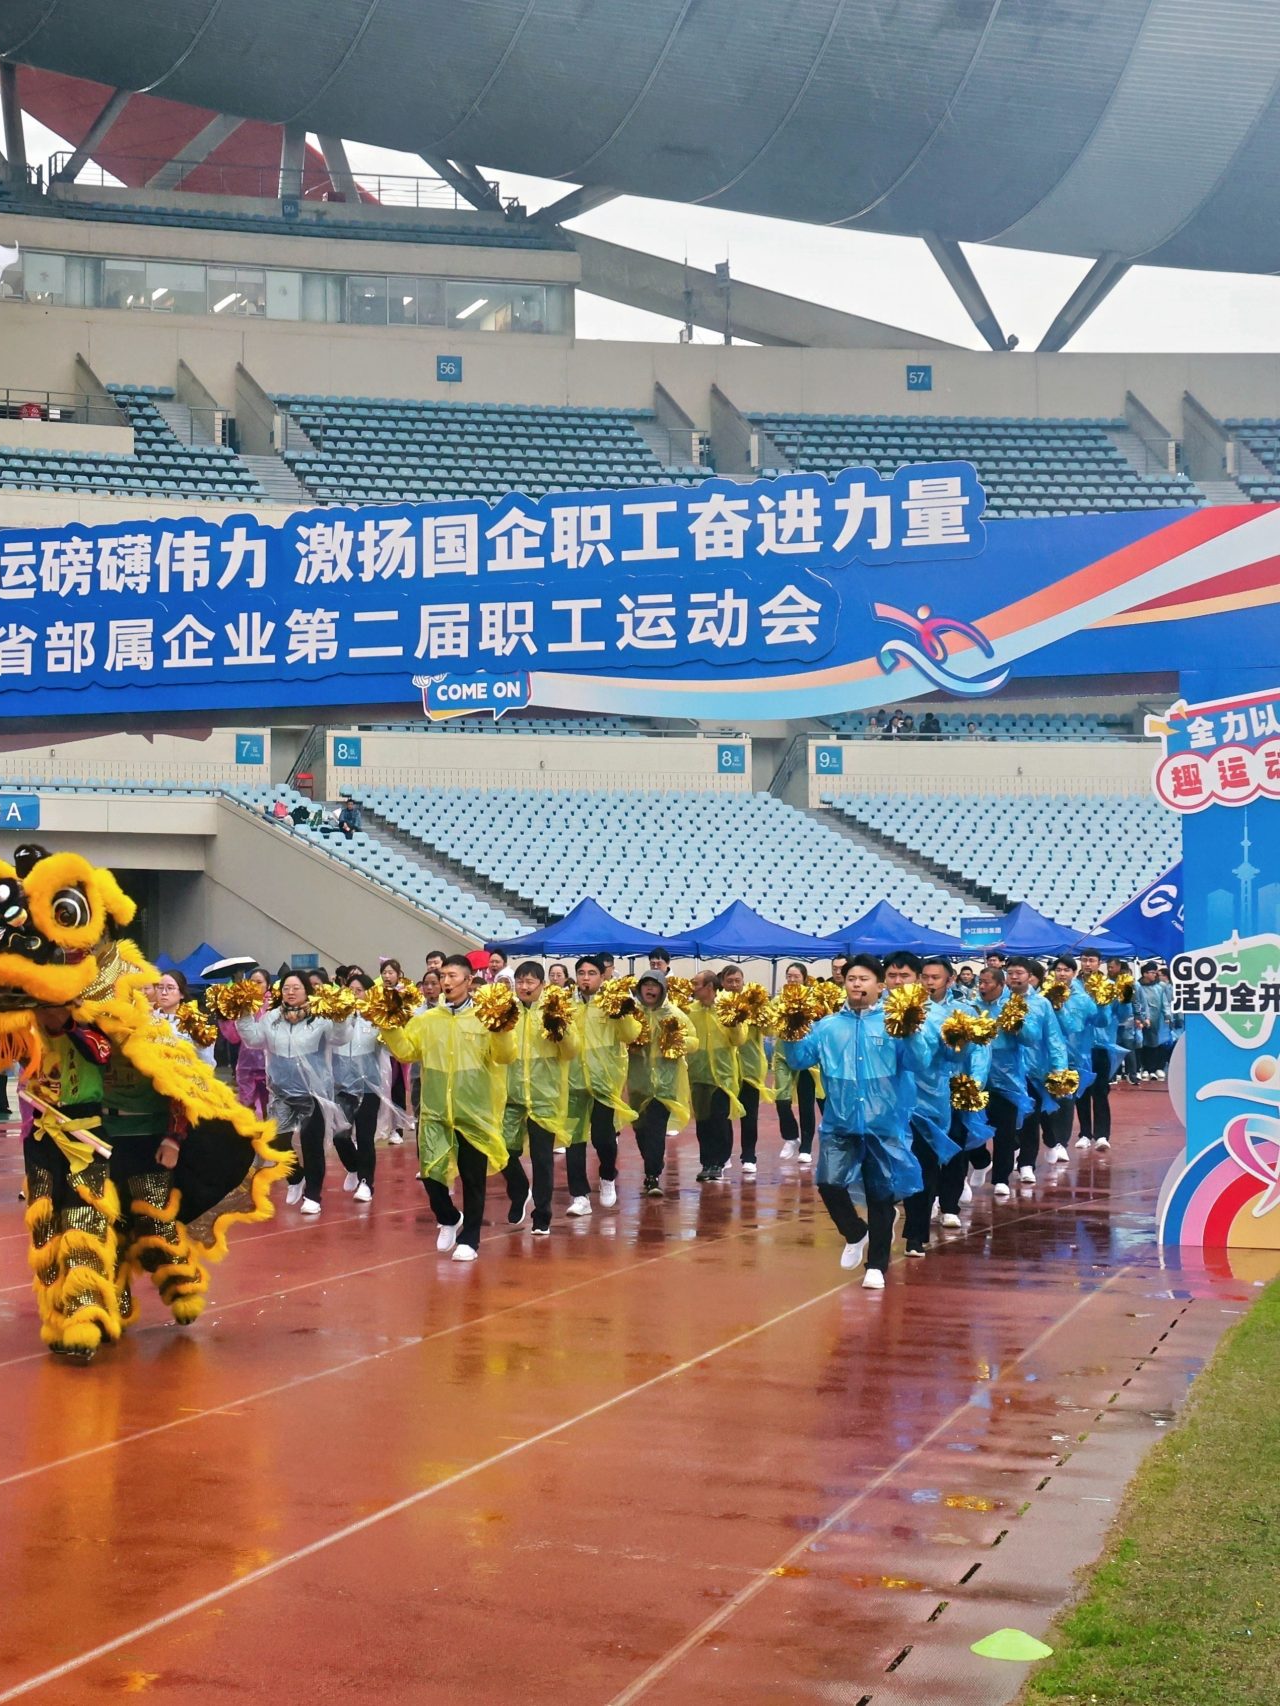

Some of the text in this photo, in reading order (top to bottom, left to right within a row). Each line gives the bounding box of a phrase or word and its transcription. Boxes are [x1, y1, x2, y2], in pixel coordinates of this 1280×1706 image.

[440, 362, 456, 375] 56
[909, 371, 926, 384] 57
[293, 476, 971, 586] 激扬国企职工奋进力量
[437, 681, 521, 701] COME ON
[337, 743, 348, 760] 8
[721, 750, 732, 767] 8
[819, 752, 830, 768] 9
[6, 802, 22, 821] A
[1173, 982, 1280, 1012] 活力全开
